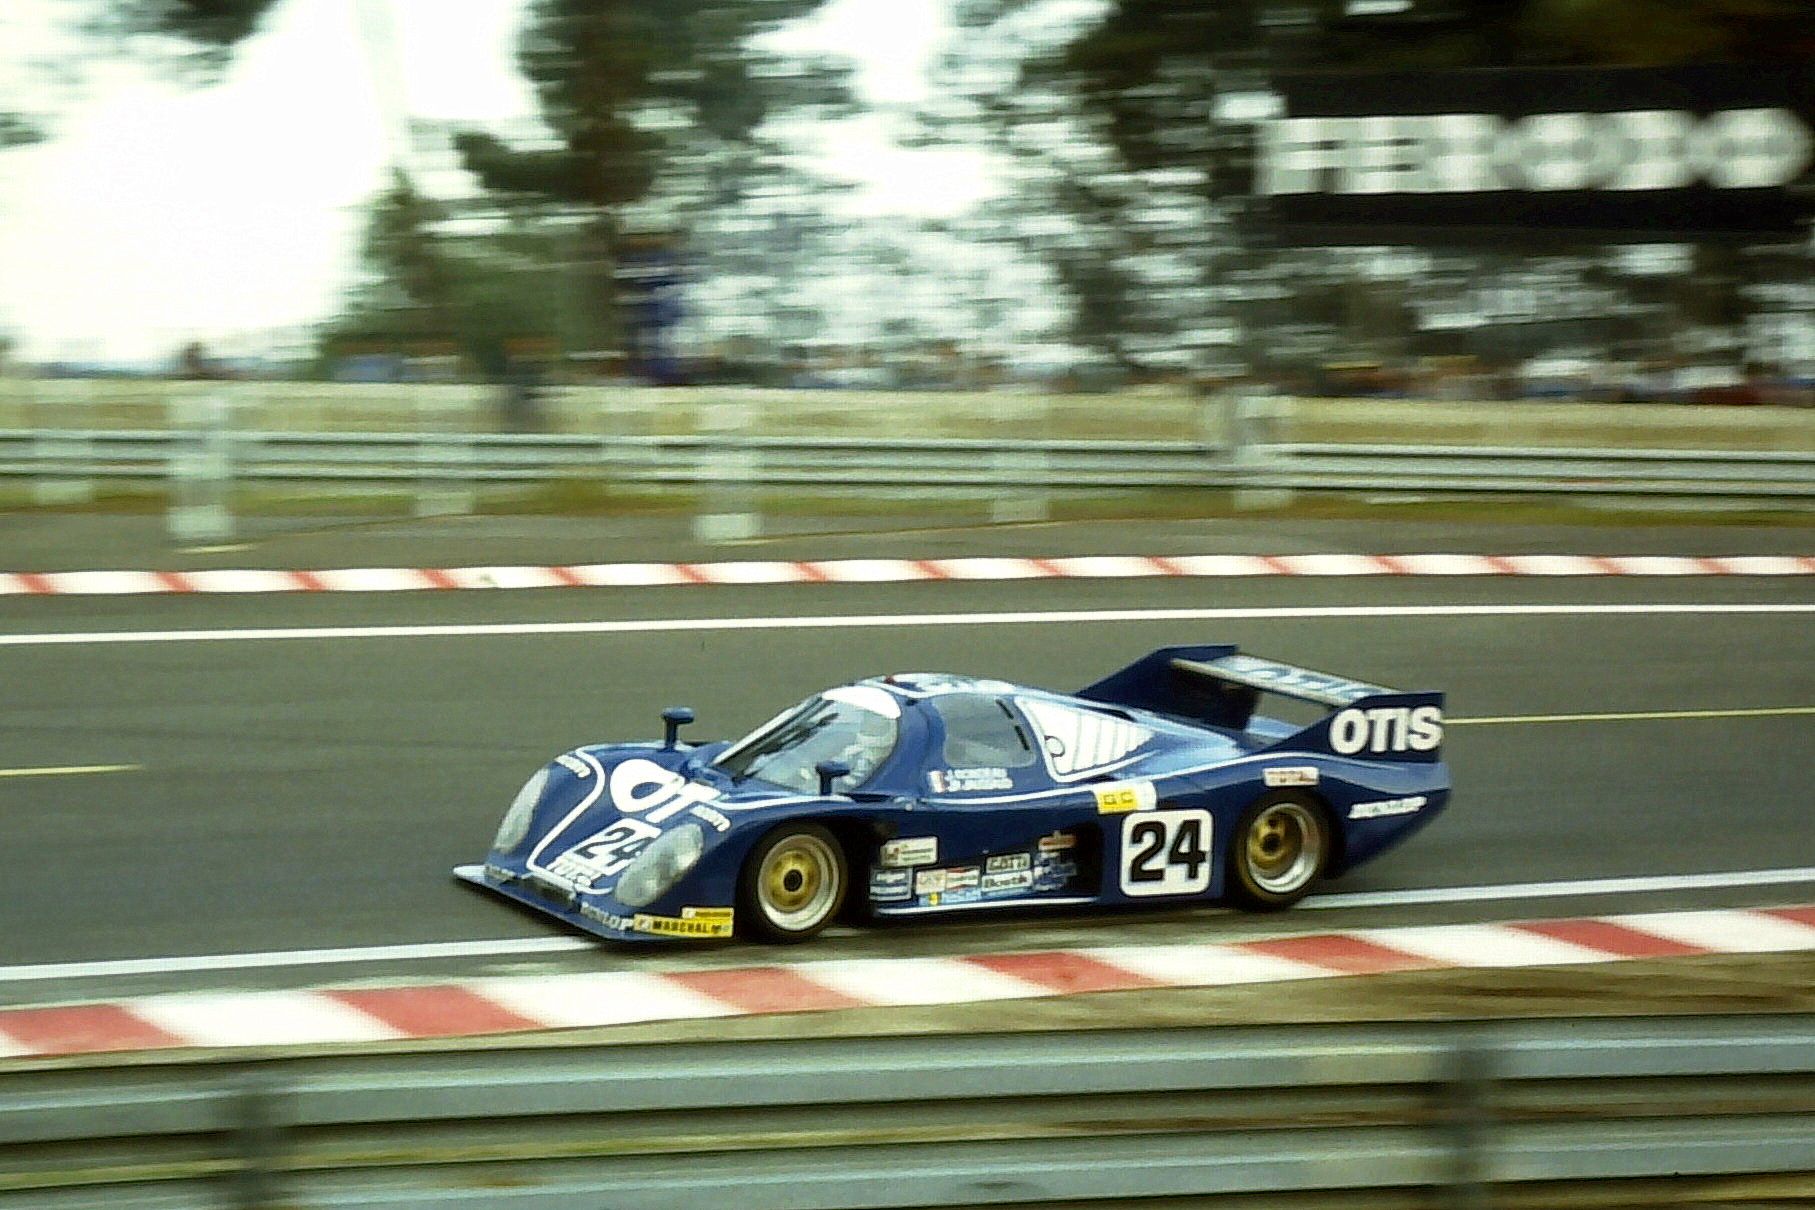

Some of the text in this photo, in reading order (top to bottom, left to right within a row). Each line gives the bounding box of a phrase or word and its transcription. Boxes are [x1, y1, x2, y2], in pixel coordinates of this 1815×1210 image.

[1329, 706, 1443, 754] OTIS
[573, 827, 650, 868] 24
[1131, 820, 1206, 881] 24
[652, 919, 709, 933] MARCHAL
